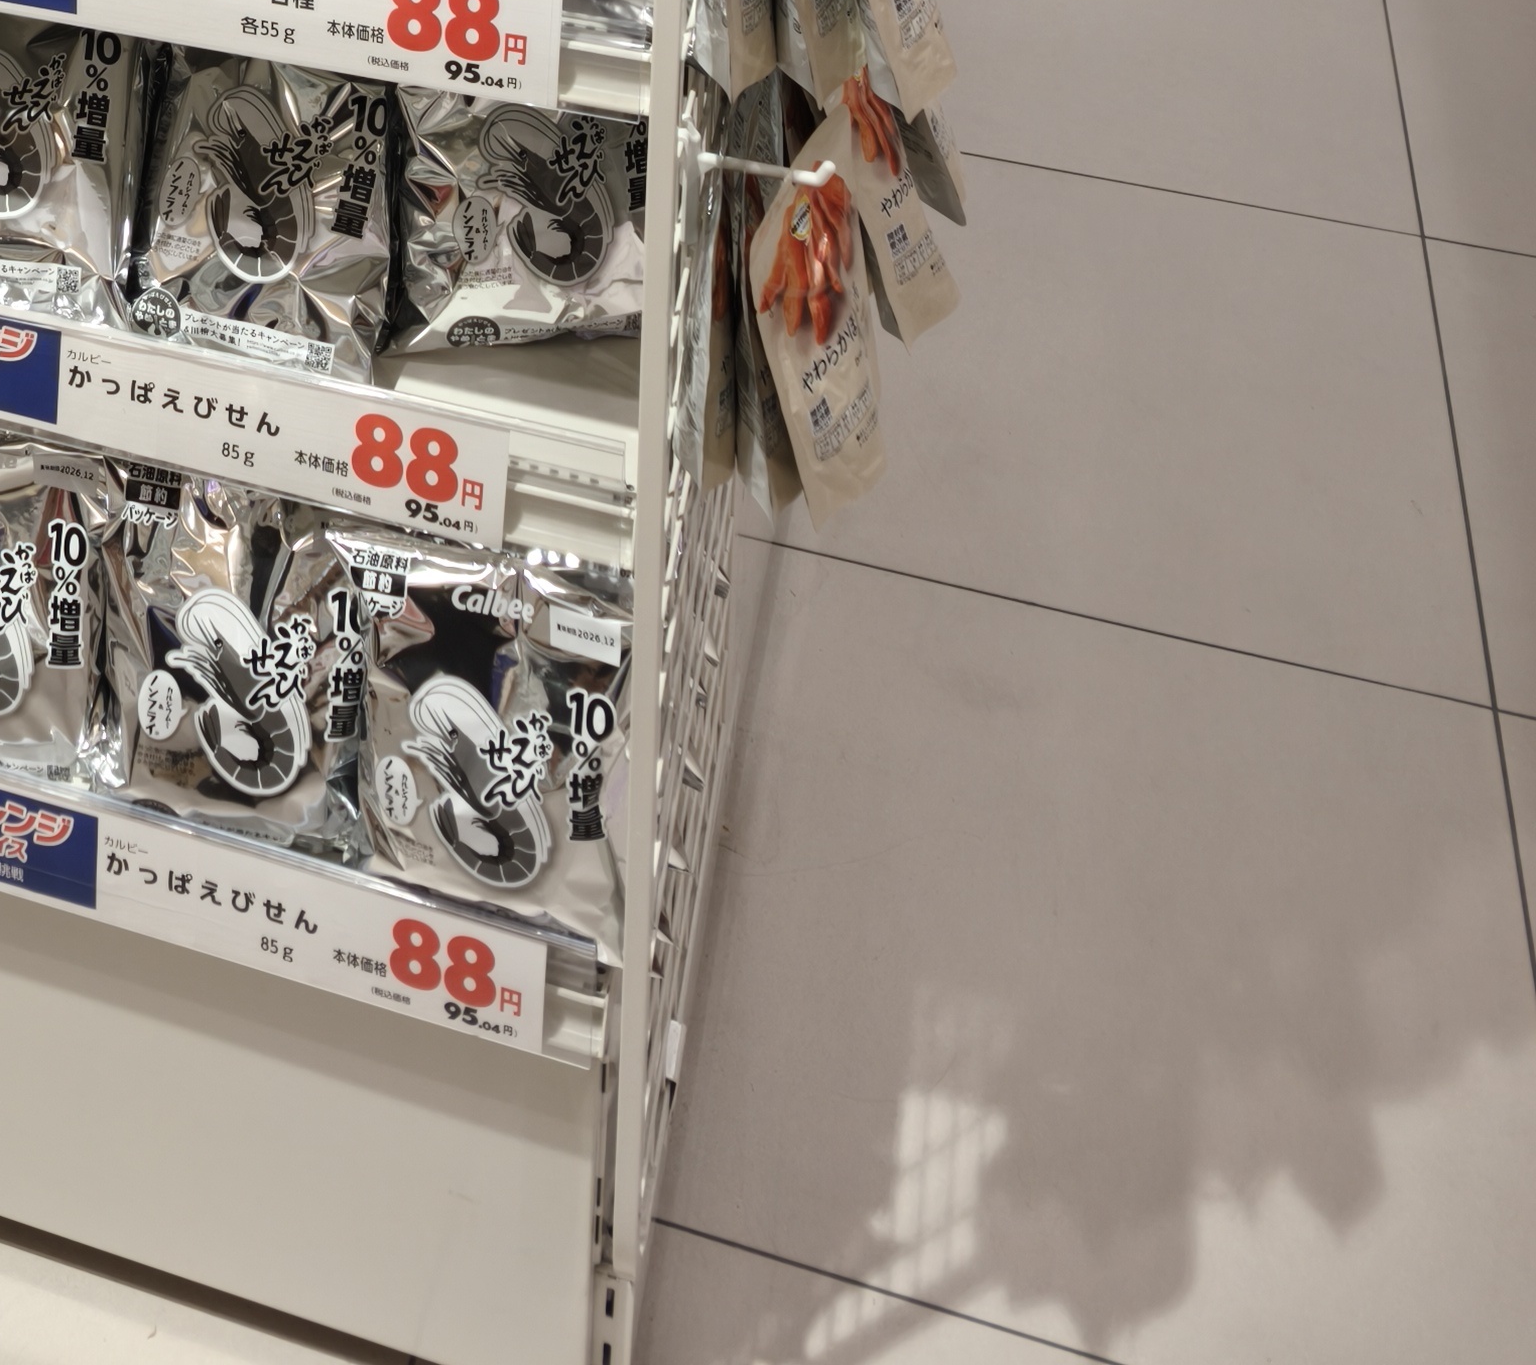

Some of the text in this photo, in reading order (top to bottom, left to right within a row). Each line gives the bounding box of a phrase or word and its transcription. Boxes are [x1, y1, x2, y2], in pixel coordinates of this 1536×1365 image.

[326, 18, 385, 45] 本体価格
[66, 349, 112, 366] カルビー
[67, 364, 281, 438] かっぱえびせん
[294, 449, 349, 478] 本体価格
[122, 504, 179, 527] パッケージ
[352, 548, 409, 571] 石油原料
[450, 584, 535, 625] Calbee
[104, 835, 148, 855] カルビー
[106, 851, 318, 935] かっぱえびせん
[332, 948, 388, 978] 本体価格
